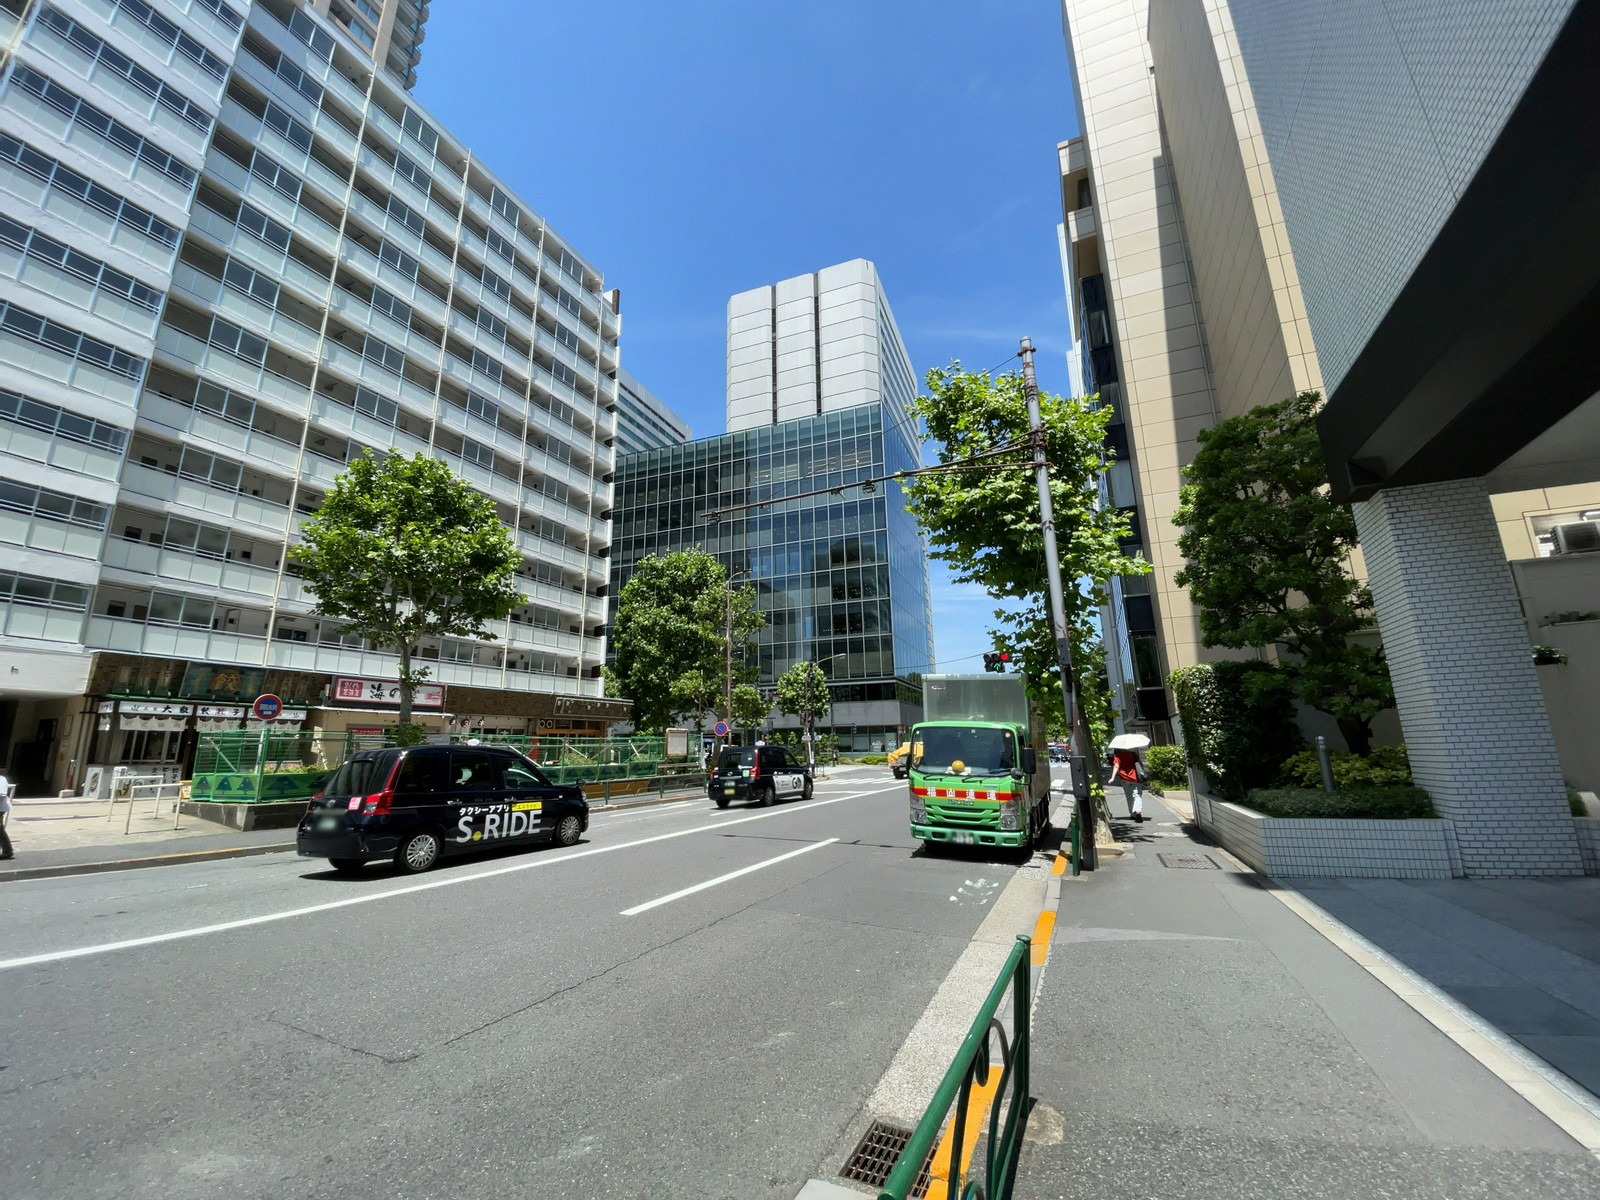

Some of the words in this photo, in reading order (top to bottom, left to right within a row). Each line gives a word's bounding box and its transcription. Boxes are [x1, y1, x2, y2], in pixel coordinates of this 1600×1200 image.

[927, 786, 997, 801] 福山通運
[459, 804, 510, 817] タクシーアプリ
[456, 809, 542, 843] S.RIDE
